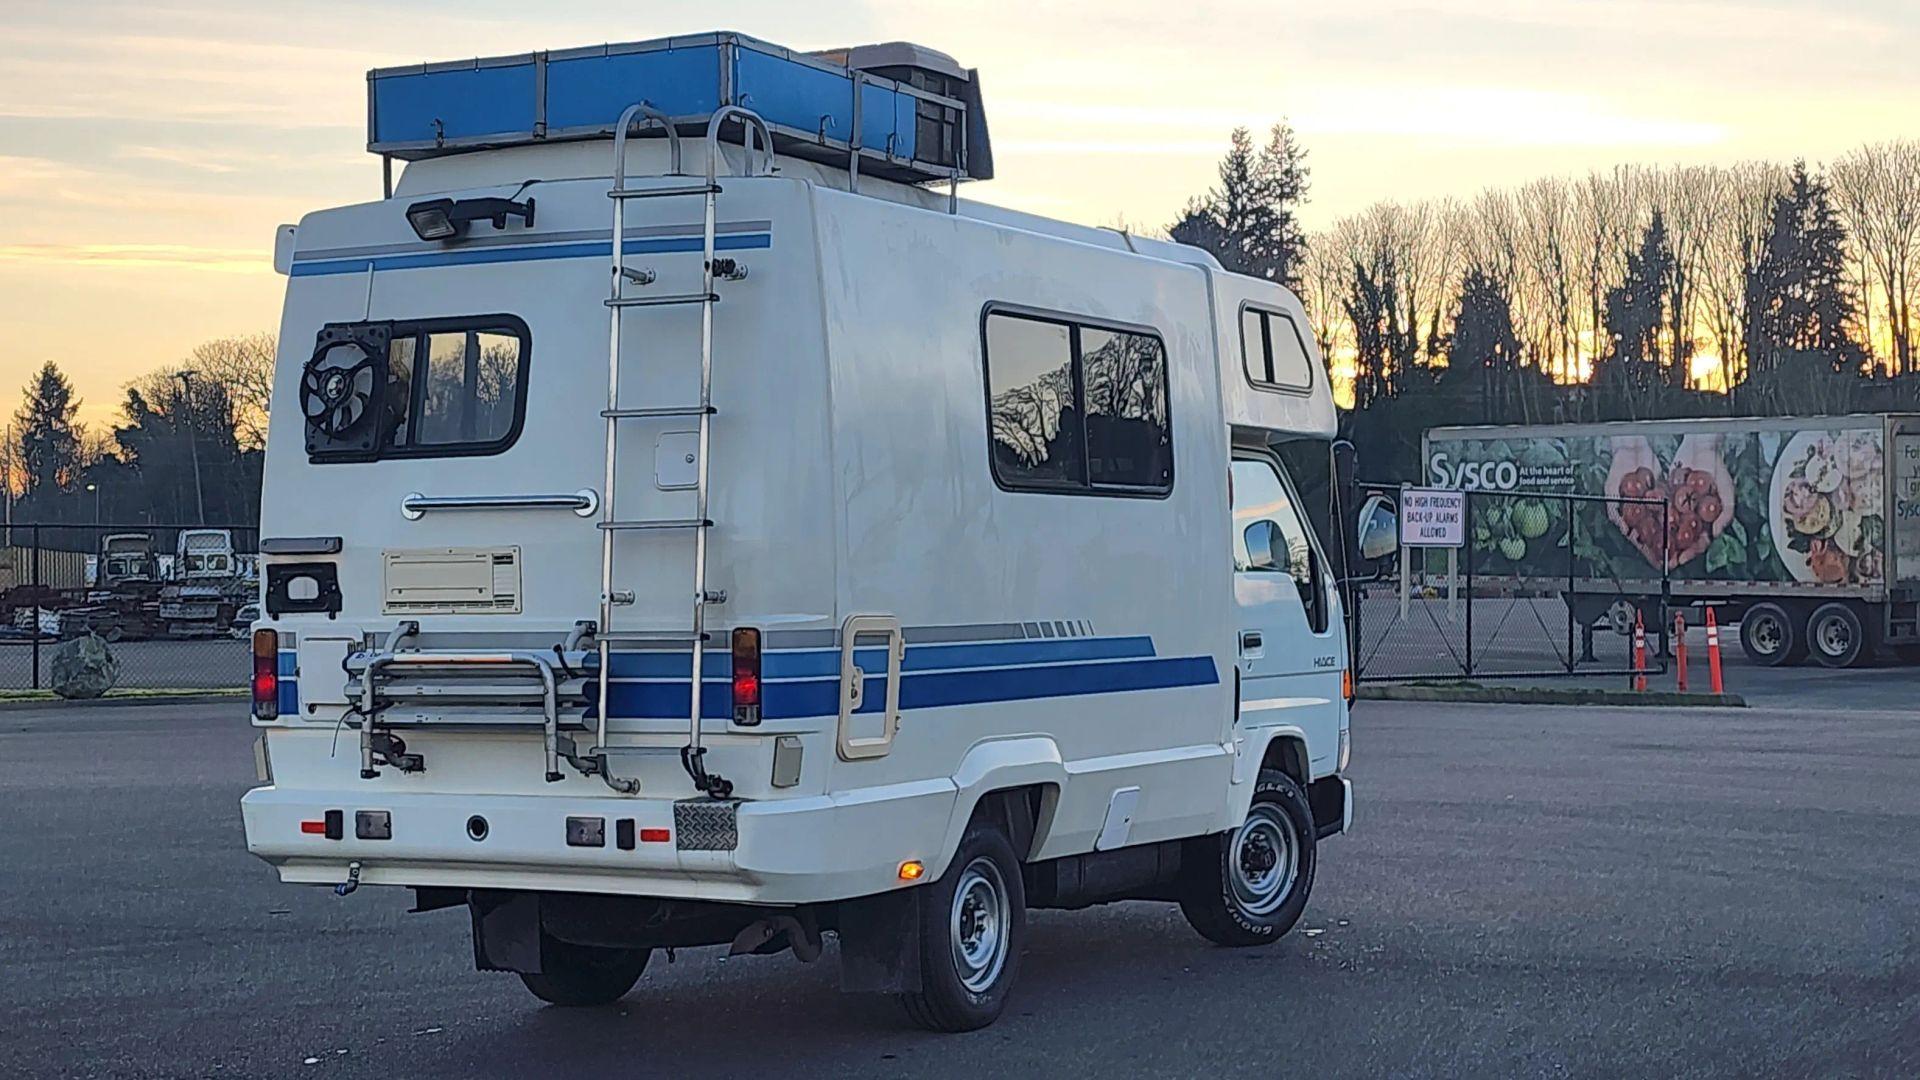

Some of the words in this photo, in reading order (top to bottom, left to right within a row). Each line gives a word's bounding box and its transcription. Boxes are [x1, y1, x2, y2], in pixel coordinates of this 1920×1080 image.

[1519, 466, 1529, 476] At
[1530, 465, 1543, 476] the
[1543, 465, 1565, 476] heart
[1565, 464, 1575, 476] of
[1519, 475, 1536, 487] food
[1536, 475, 1550, 486] and
[1550, 475, 1575, 486] service
[1404, 496, 1413, 508] NO
[1414, 496, 1429, 508] HIGH
[1430, 496, 1462, 509] FREQUENCY
[1406, 511, 1433, 524] BACK-UP
[1436, 511, 1459, 524] ALARMS
[1419, 526, 1447, 539] ALLOWED
